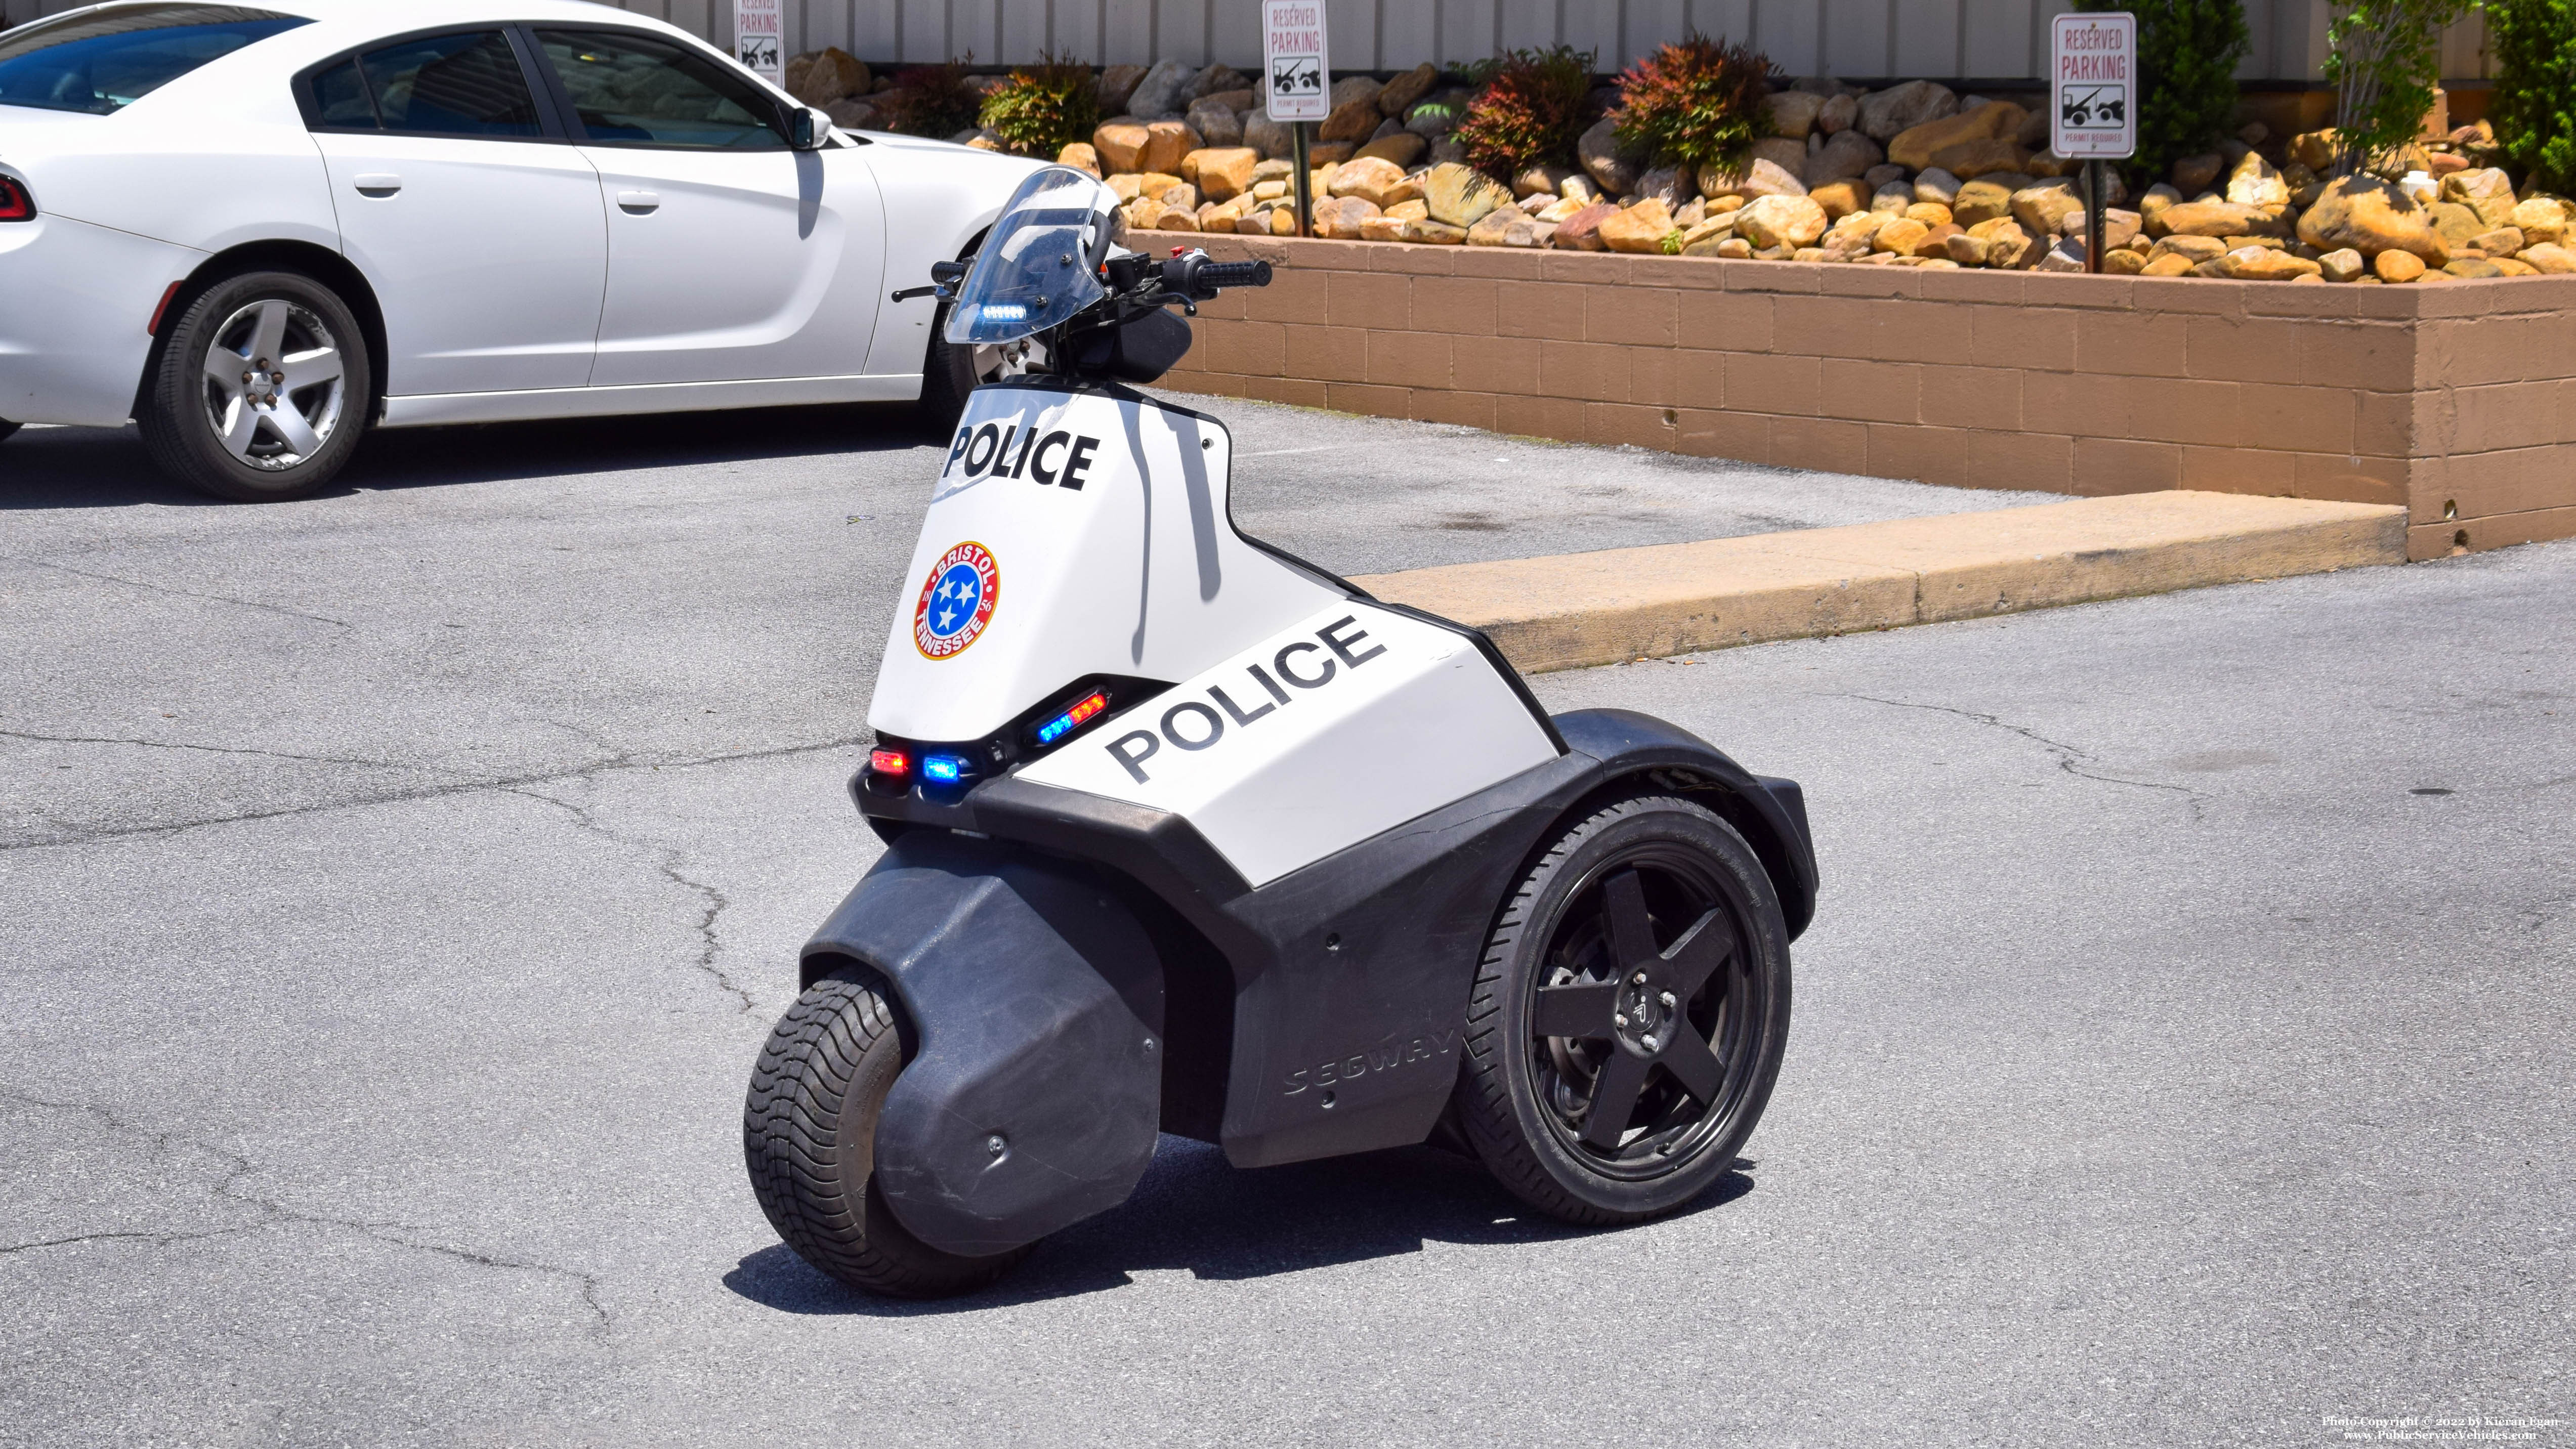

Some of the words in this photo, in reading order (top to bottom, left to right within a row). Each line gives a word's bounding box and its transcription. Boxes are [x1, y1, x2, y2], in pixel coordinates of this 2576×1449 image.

[742, 0, 775, 10] RESERVED
[740, 13, 777, 33] PARKING
[1273, 8, 1316, 27] RESERVED
[1272, 31, 1320, 53] PARKING
[2065, 28, 2123, 50] RESERVED
[2062, 54, 2126, 80] PARKING
[2065, 133, 2089, 142] PERMIT
[2091, 133, 2122, 142] REQUIRED
[943, 423, 1101, 491] POLICE
[937, 545, 995, 584] BRISTOL
[921, 590, 931, 602] 18
[979, 600, 993, 612] 56
[916, 609, 984, 656] TENNESSEE
[1105, 615, 1388, 785] POLICE
[1284, 1028, 1454, 1095] SEGWAY
